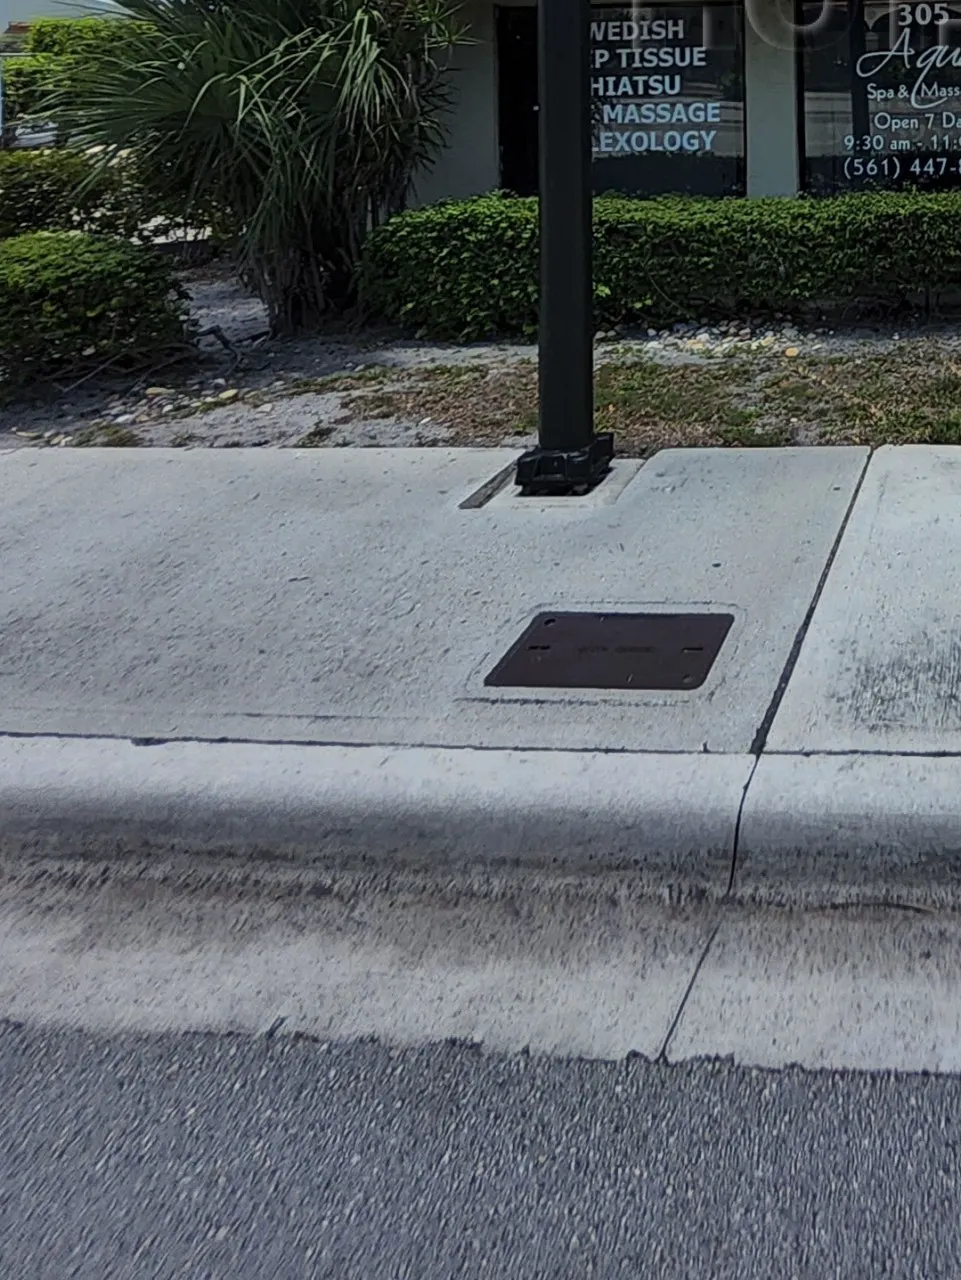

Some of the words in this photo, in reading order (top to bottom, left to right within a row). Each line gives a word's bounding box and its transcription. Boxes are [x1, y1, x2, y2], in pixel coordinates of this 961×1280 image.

[898, 3, 949, 26] 305
[590, 20, 685, 41] WEDISH
[615, 47, 708, 68] TISSUE
[591, 75, 682, 96] HIATSU
[867, 83, 895, 101] Spa
[897, 84, 909, 99] &
[603, 103, 721, 124] MASSAGE
[874, 112, 918, 132] Open
[925, 113, 934, 129] 7
[844, 134, 884, 151] 9:30
[890, 139, 911, 151] am
[843, 156, 900, 180] (561)
